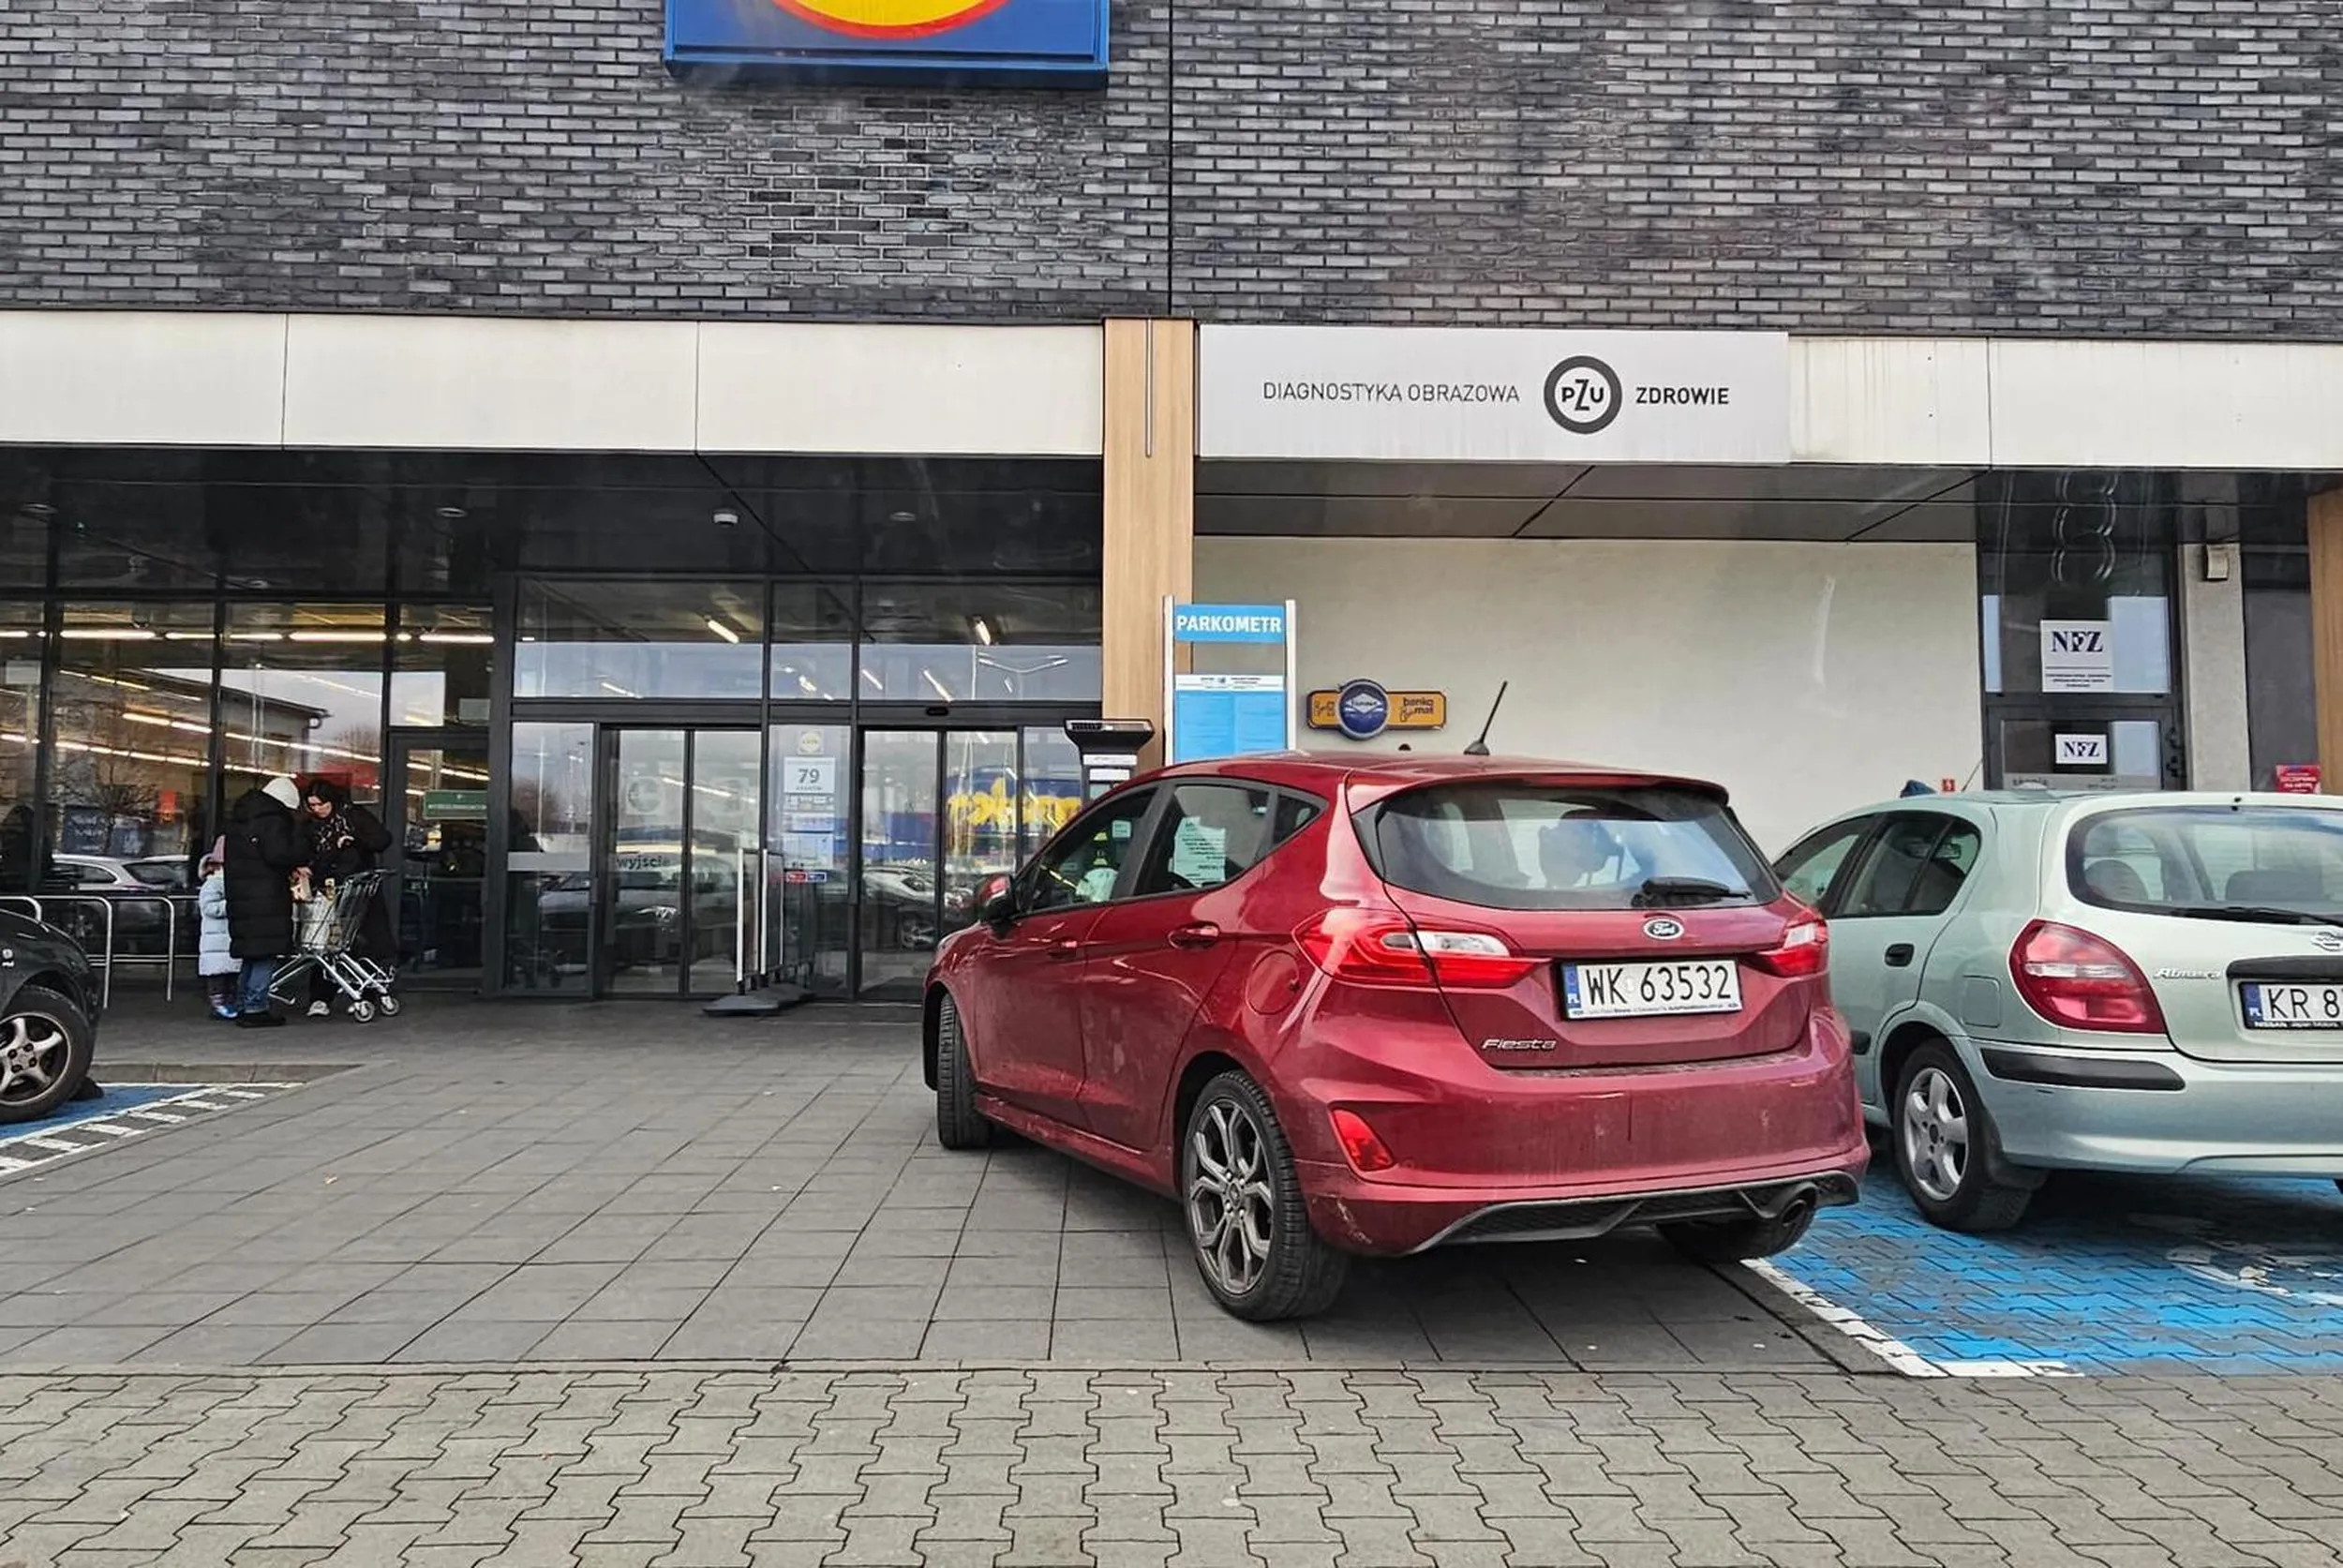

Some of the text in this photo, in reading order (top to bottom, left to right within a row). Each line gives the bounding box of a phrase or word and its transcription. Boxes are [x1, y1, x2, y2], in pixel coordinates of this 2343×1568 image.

[1263, 379, 1730, 411] DIAGNOSTYKA OBRAZOWA PZU ZDROWIE
[1176, 615, 1282, 634] PARKOMETR
[2051, 631, 2103, 652] NFZ
[2064, 741, 2099, 757] NFZ
[798, 768, 820, 784] 79
[1586, 965, 1732, 1006] WK 63532
[1567, 993, 1580, 1004] PL
[2268, 989, 2343, 1019] KR 8
[2249, 1008, 2261, 1016] PL
[1482, 1038, 1557, 1050] Fiesta
